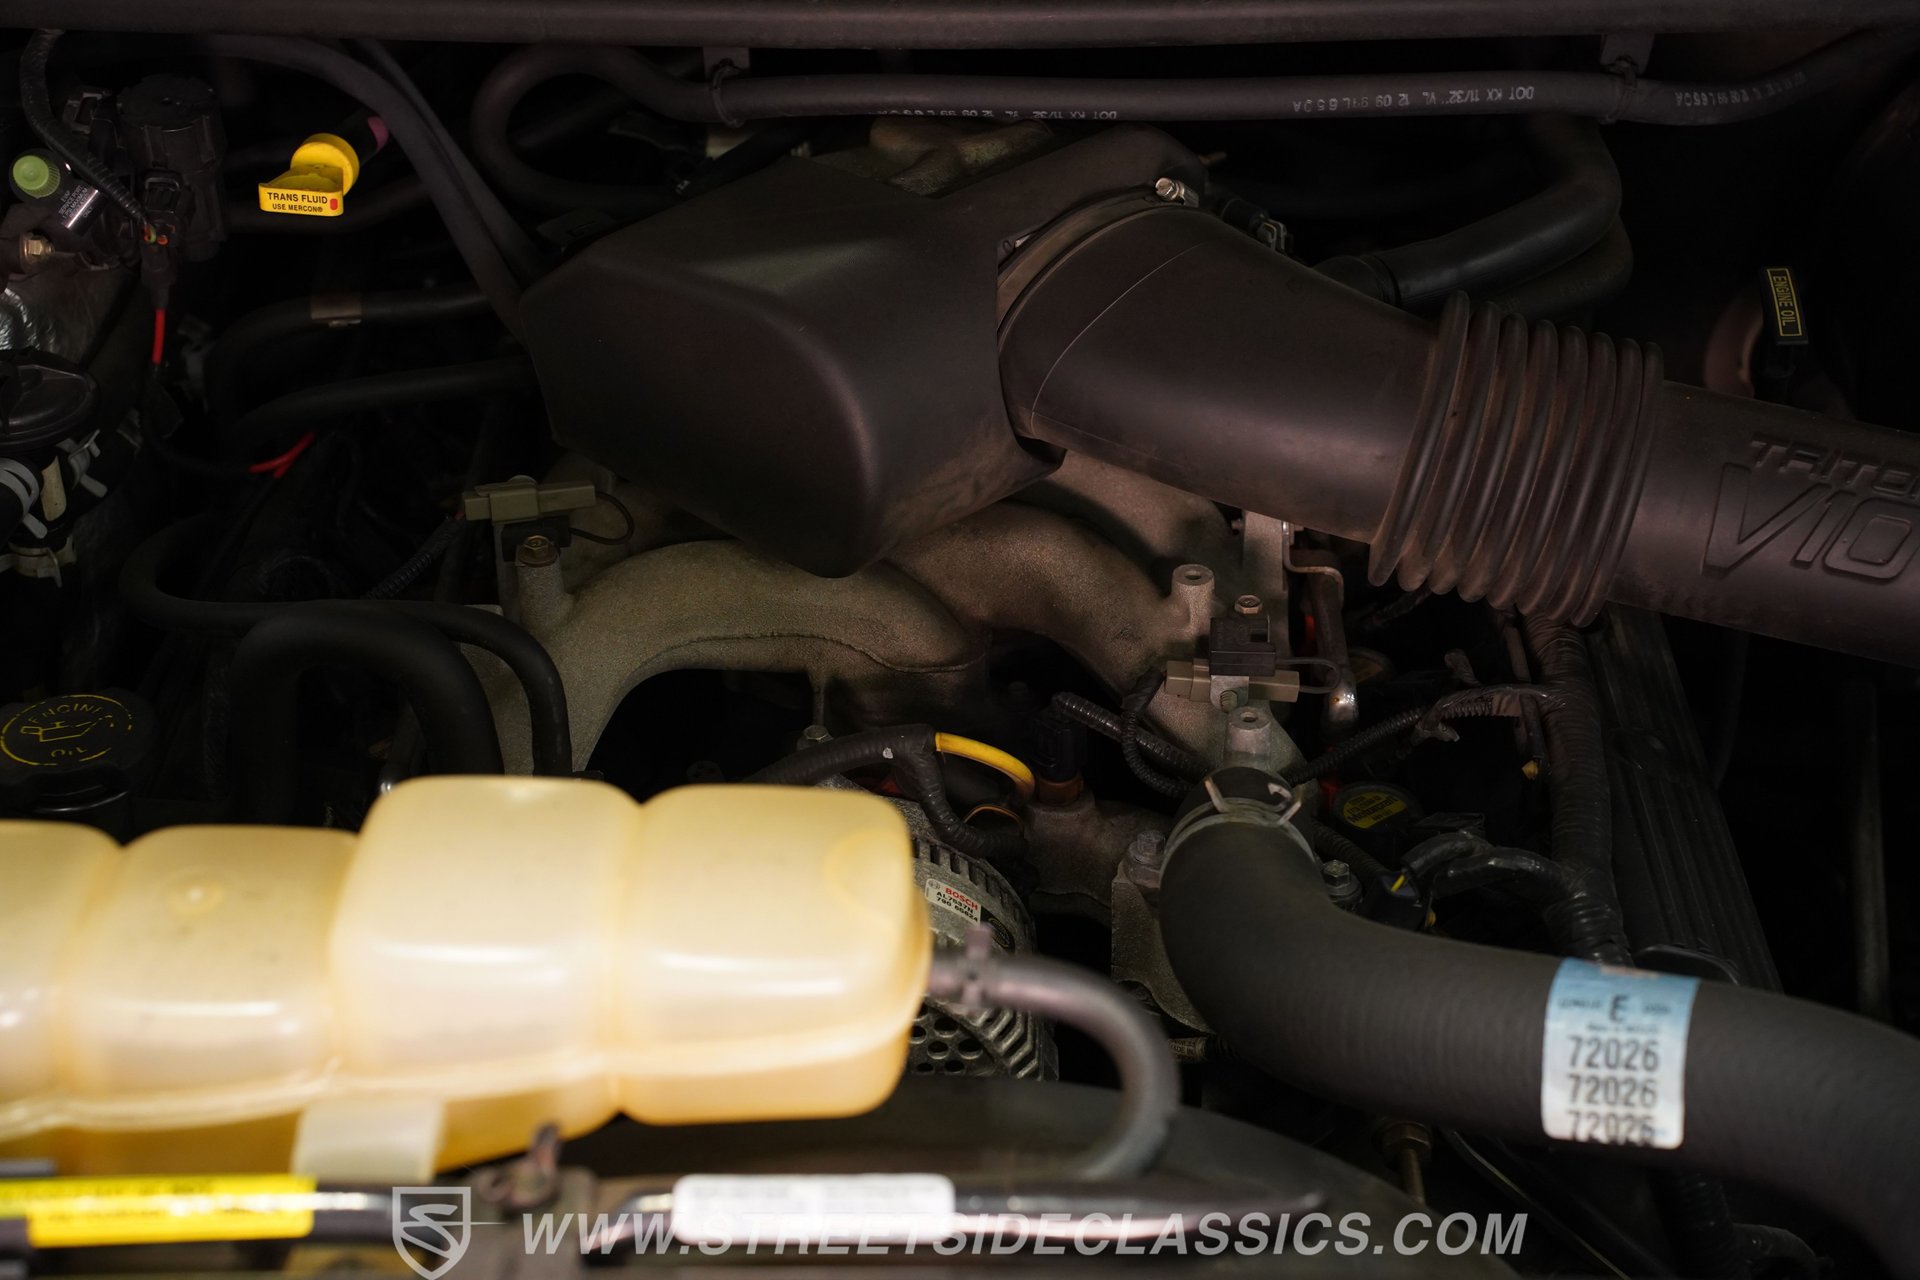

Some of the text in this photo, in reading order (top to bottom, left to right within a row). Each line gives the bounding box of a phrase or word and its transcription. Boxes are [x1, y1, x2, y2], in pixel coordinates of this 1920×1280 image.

[1375, 94, 1393, 108] 09
[1397, 93, 1411, 107] 12
[1486, 88, 1503, 102] KX
[1508, 86, 1534, 101] DOT
[1070, 110, 1086, 120] KX
[1092, 110, 1117, 120] DOT
[267, 192, 328, 205] TRANS FLUID
[1772, 275, 1796, 327] ENGINE OIL
[1751, 434, 1920, 500] TRITO
[1702, 462, 1920, 585] V10
[945, 887, 978, 910] BOSCH
[1568, 1035, 1659, 1073] 72026
[1567, 1074, 1658, 1109] 72026
